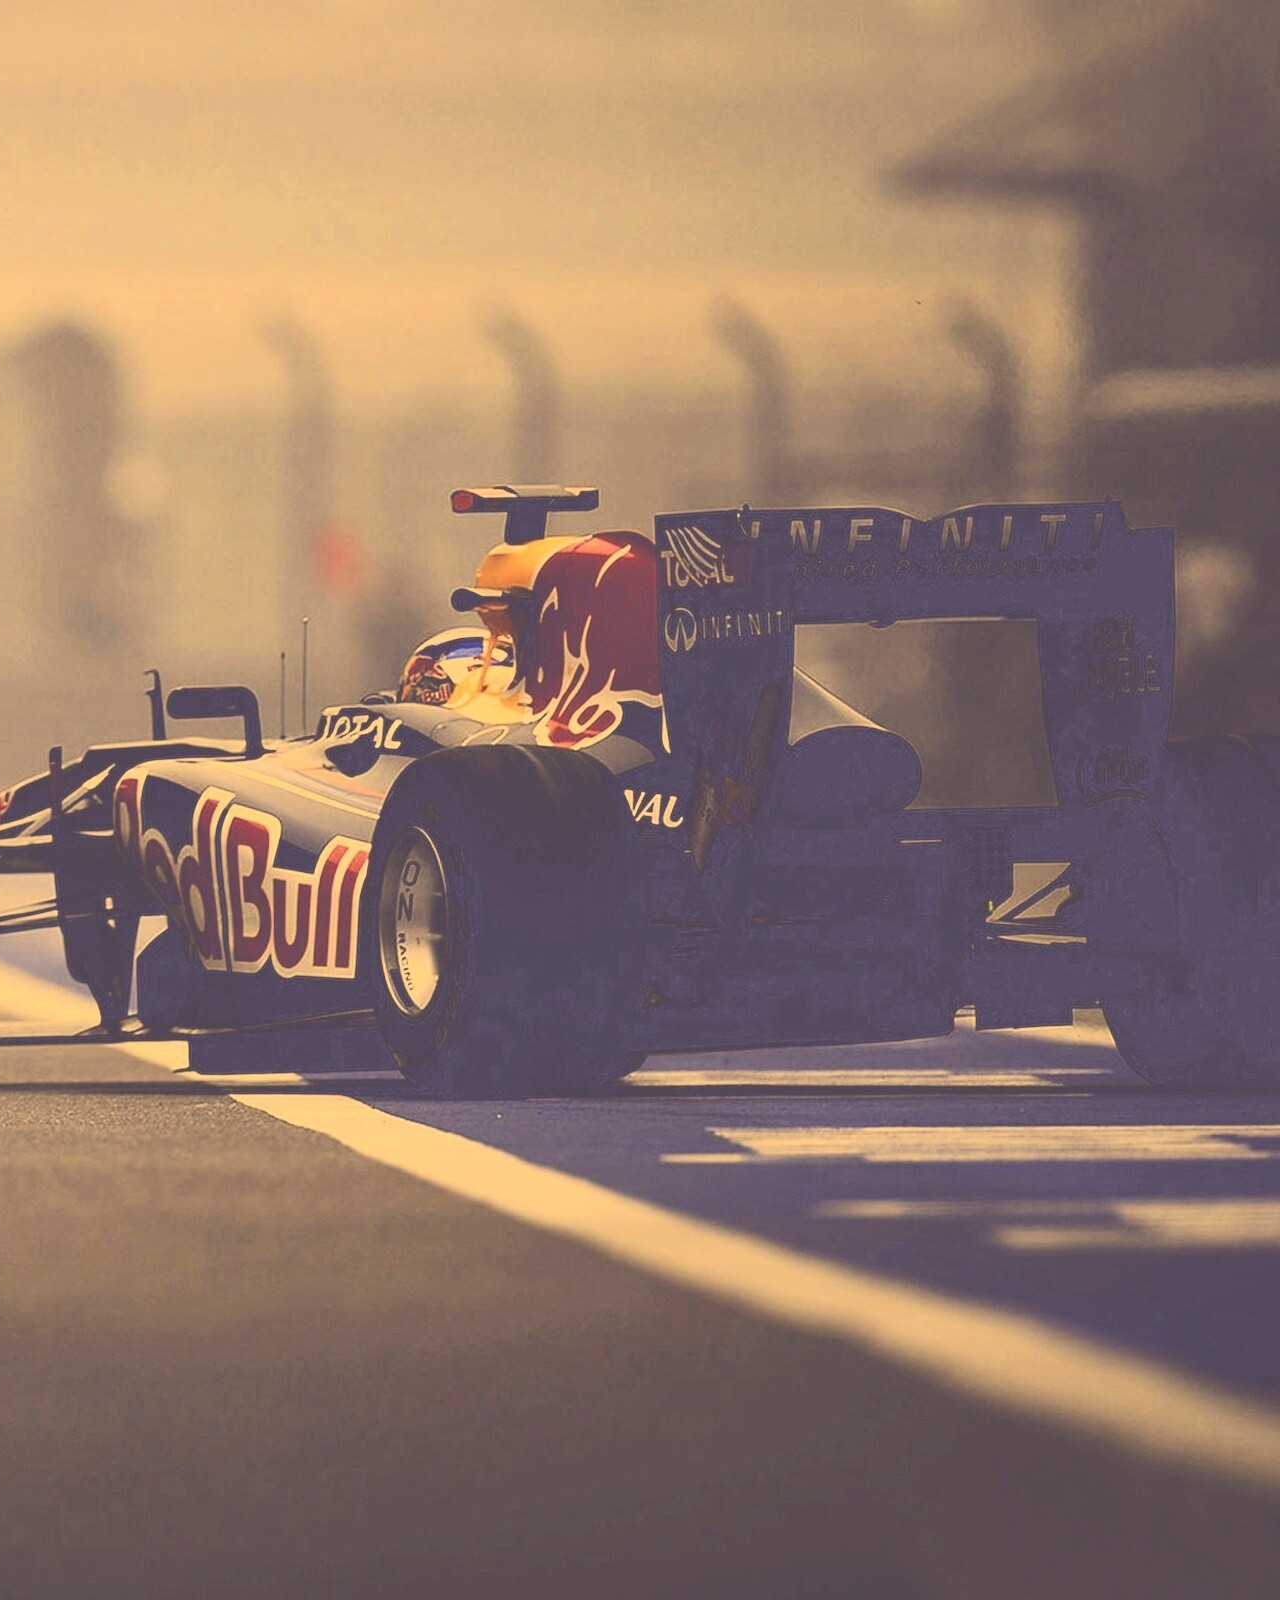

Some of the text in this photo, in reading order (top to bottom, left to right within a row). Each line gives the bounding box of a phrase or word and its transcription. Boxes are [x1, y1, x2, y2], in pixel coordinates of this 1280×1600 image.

[701, 610, 791, 640] INFINITI
[322, 706, 403, 749] TOTAL
[224, 804, 372, 978] Bull
